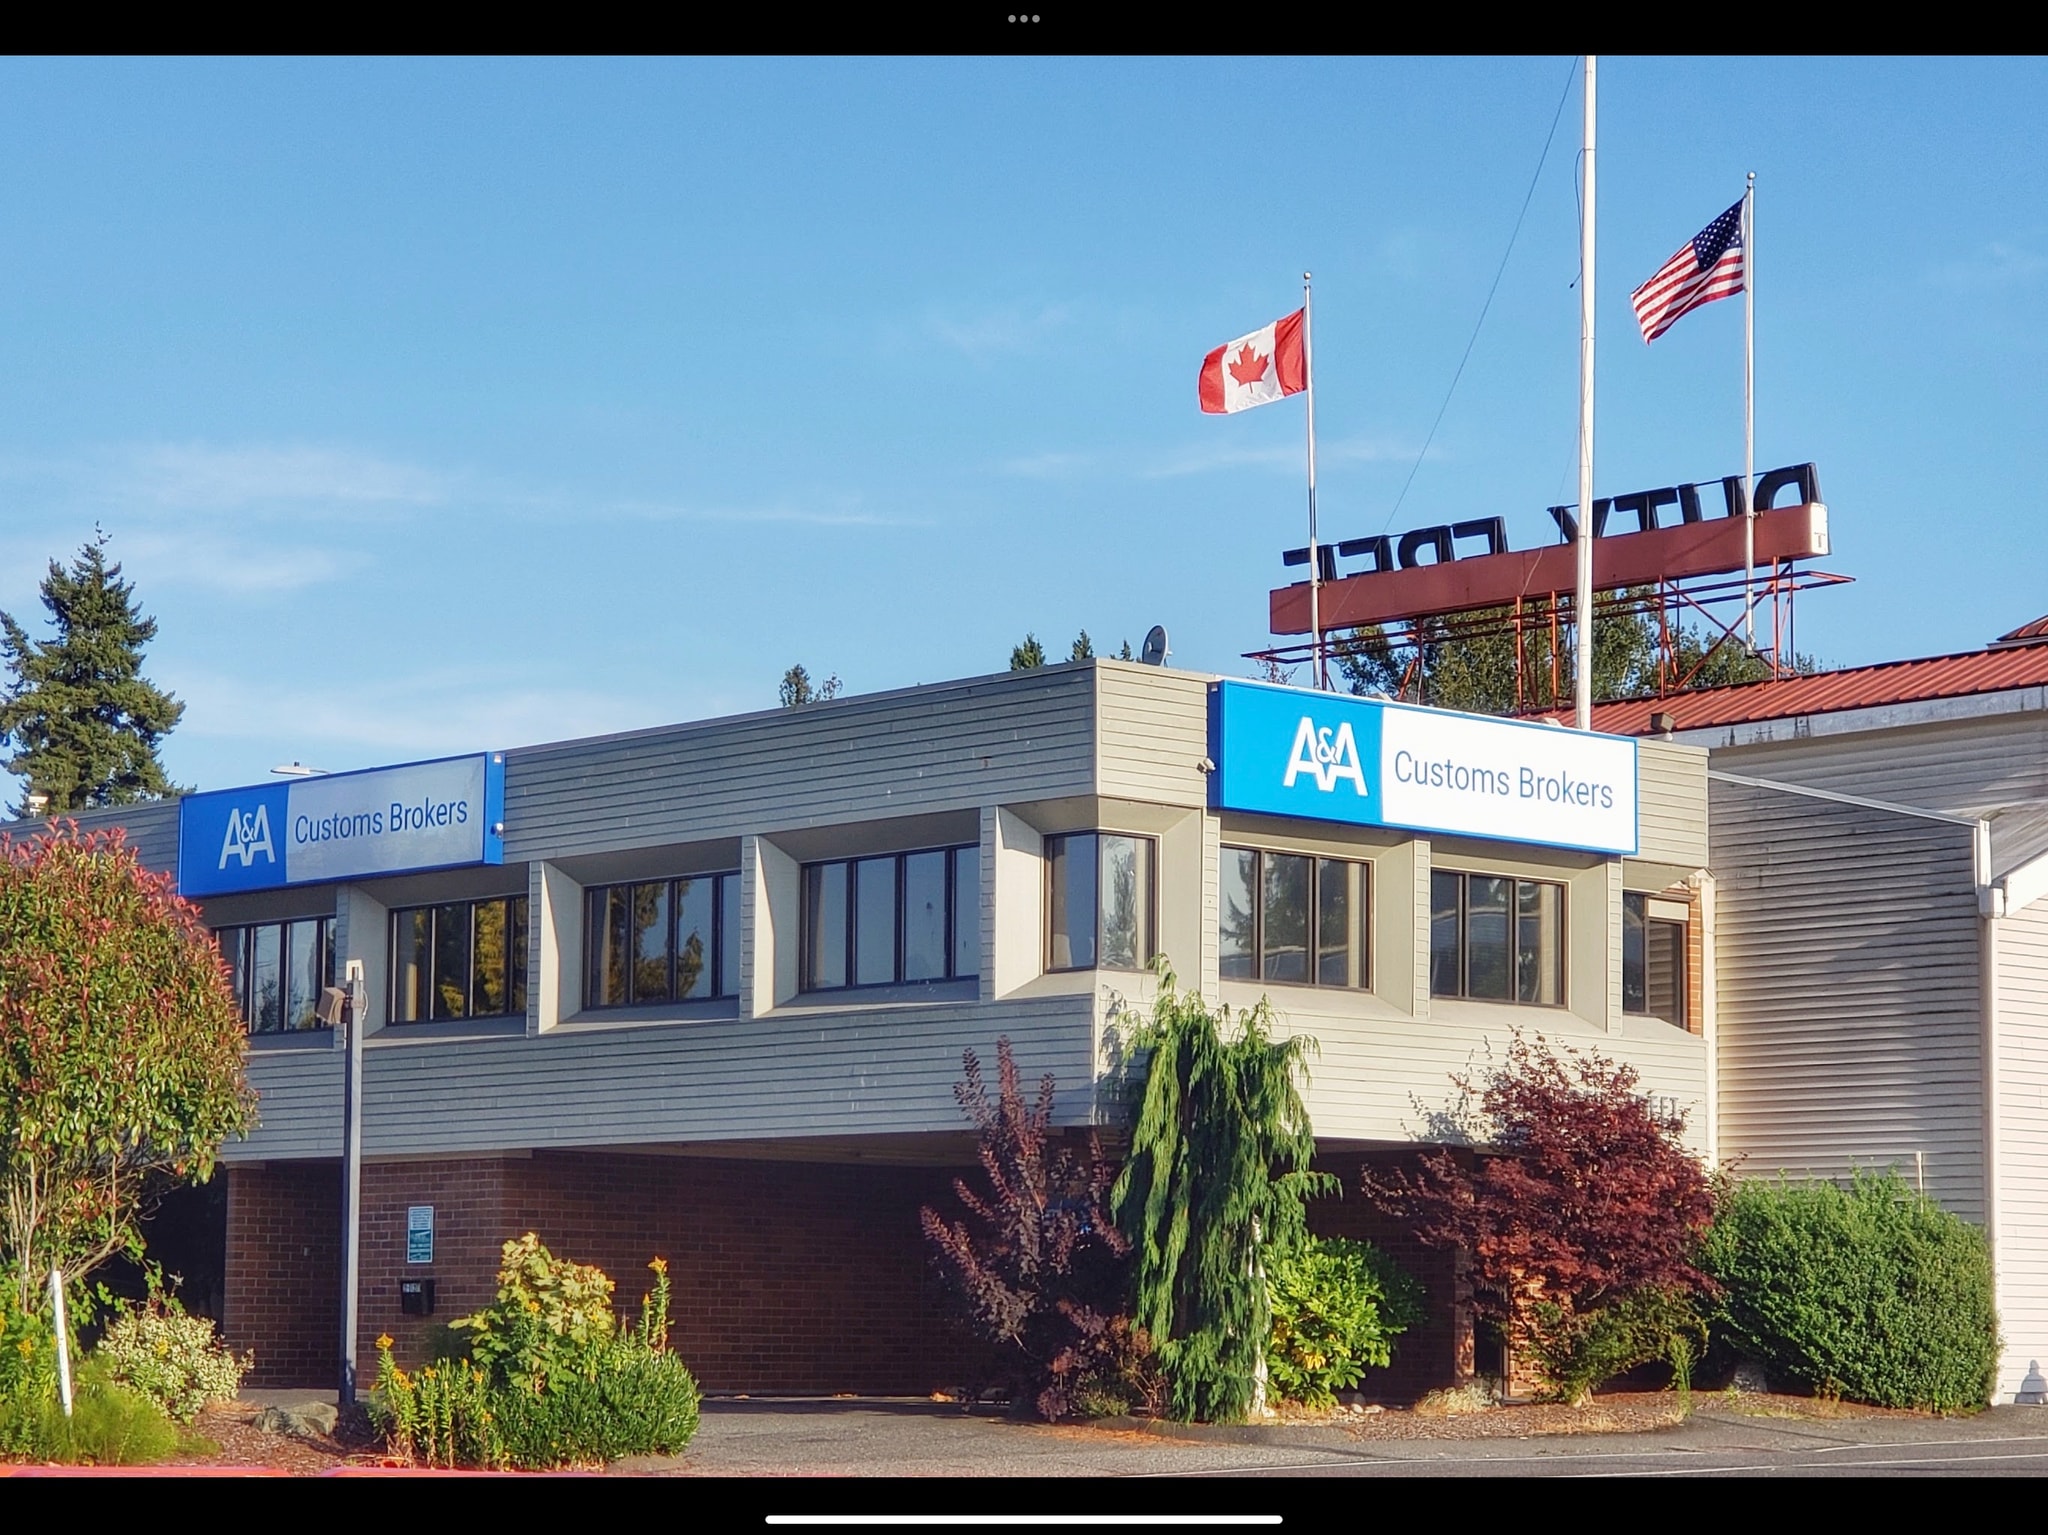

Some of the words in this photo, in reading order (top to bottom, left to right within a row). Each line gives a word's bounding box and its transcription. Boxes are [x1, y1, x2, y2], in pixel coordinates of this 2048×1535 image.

[1283, 716, 1369, 797] A&A
[1394, 750, 1510, 796] Customs
[1519, 767, 1614, 809] Brokers
[218, 803, 276, 870] A&A
[295, 811, 383, 844] Customs
[389, 797, 468, 833] Brokers
